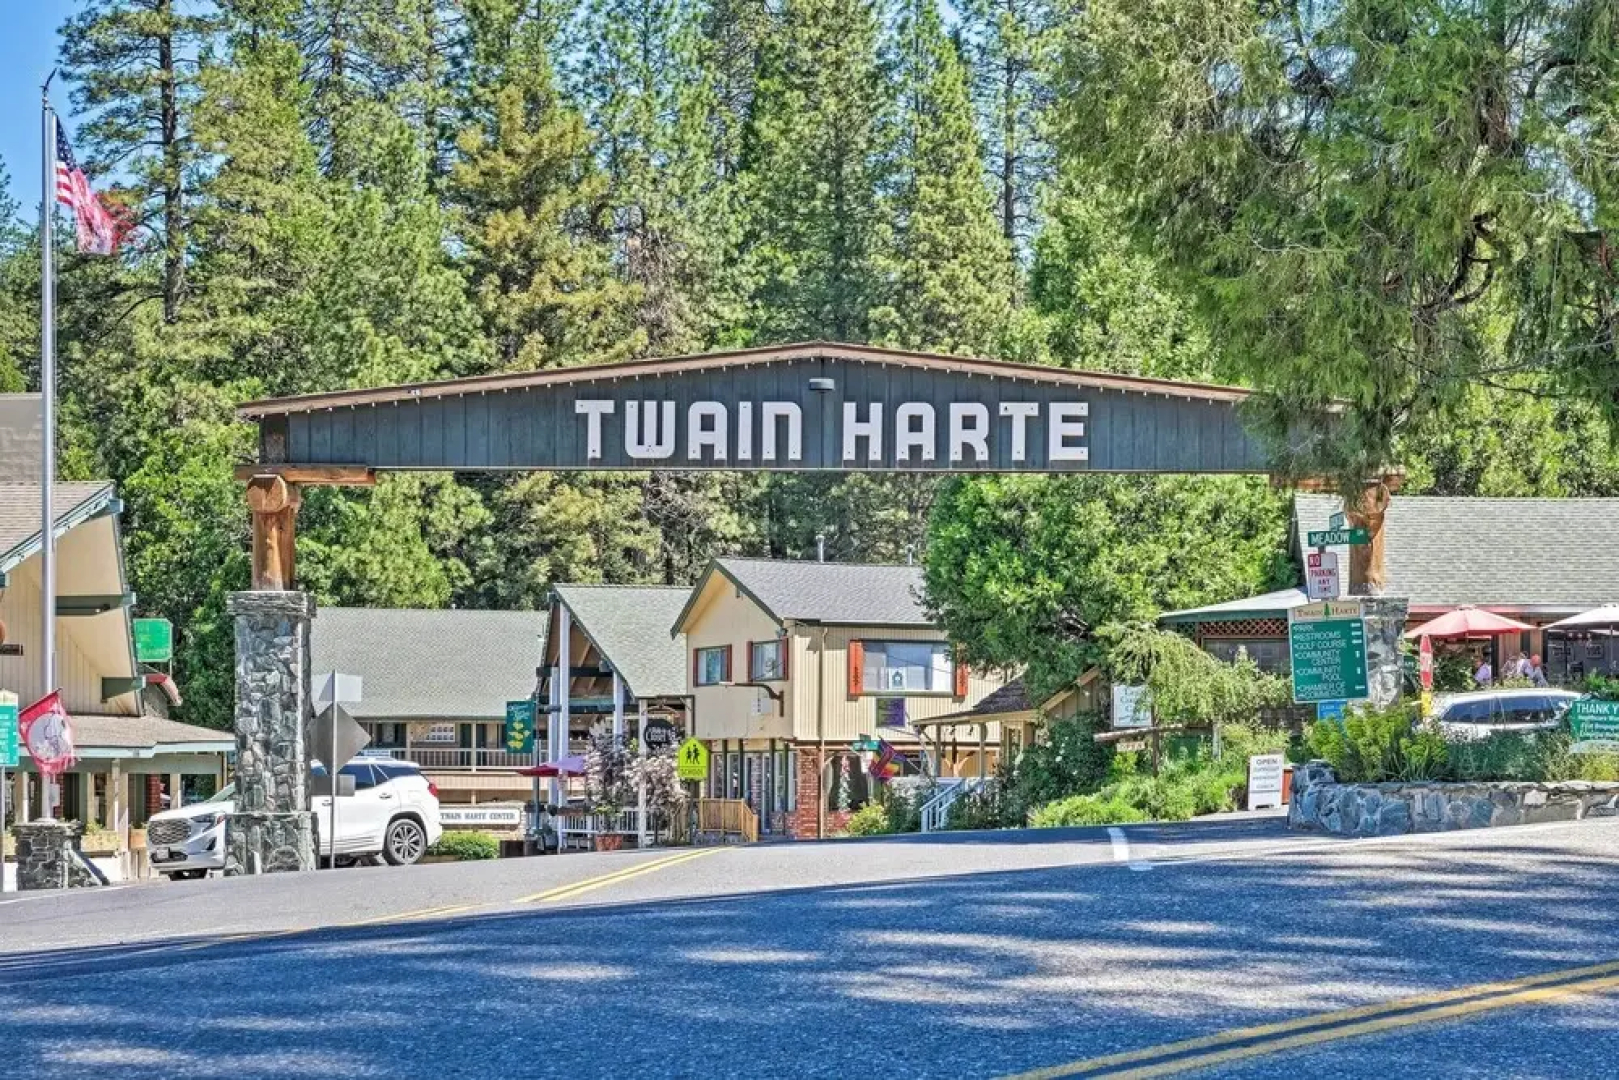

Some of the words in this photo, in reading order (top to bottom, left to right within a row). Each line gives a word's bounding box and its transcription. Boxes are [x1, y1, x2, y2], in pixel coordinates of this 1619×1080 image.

[575, 400, 802, 461] TWAIN
[843, 402, 1089, 461] HARTE
[1310, 531, 1350, 545] MEADOW
[1309, 555, 1320, 566] NO
[1310, 569, 1336, 577] PARKING
[1296, 631, 1341, 641] RESTROOMS
[1297, 641, 1315, 650] GOLF
[1318, 639, 1347, 649] COURSE
[1297, 649, 1340, 659] COMMUNITY
[1312, 657, 1340, 666] CENTER
[1298, 665, 1340, 675] COMMUNITY
[1577, 703, 1610, 715] THANK
[680, 768, 704, 776] SCHOOL
[440, 812, 461, 820] TWAIN
[464, 812, 486, 820] HARTE
[489, 812, 516, 820] CENTER
